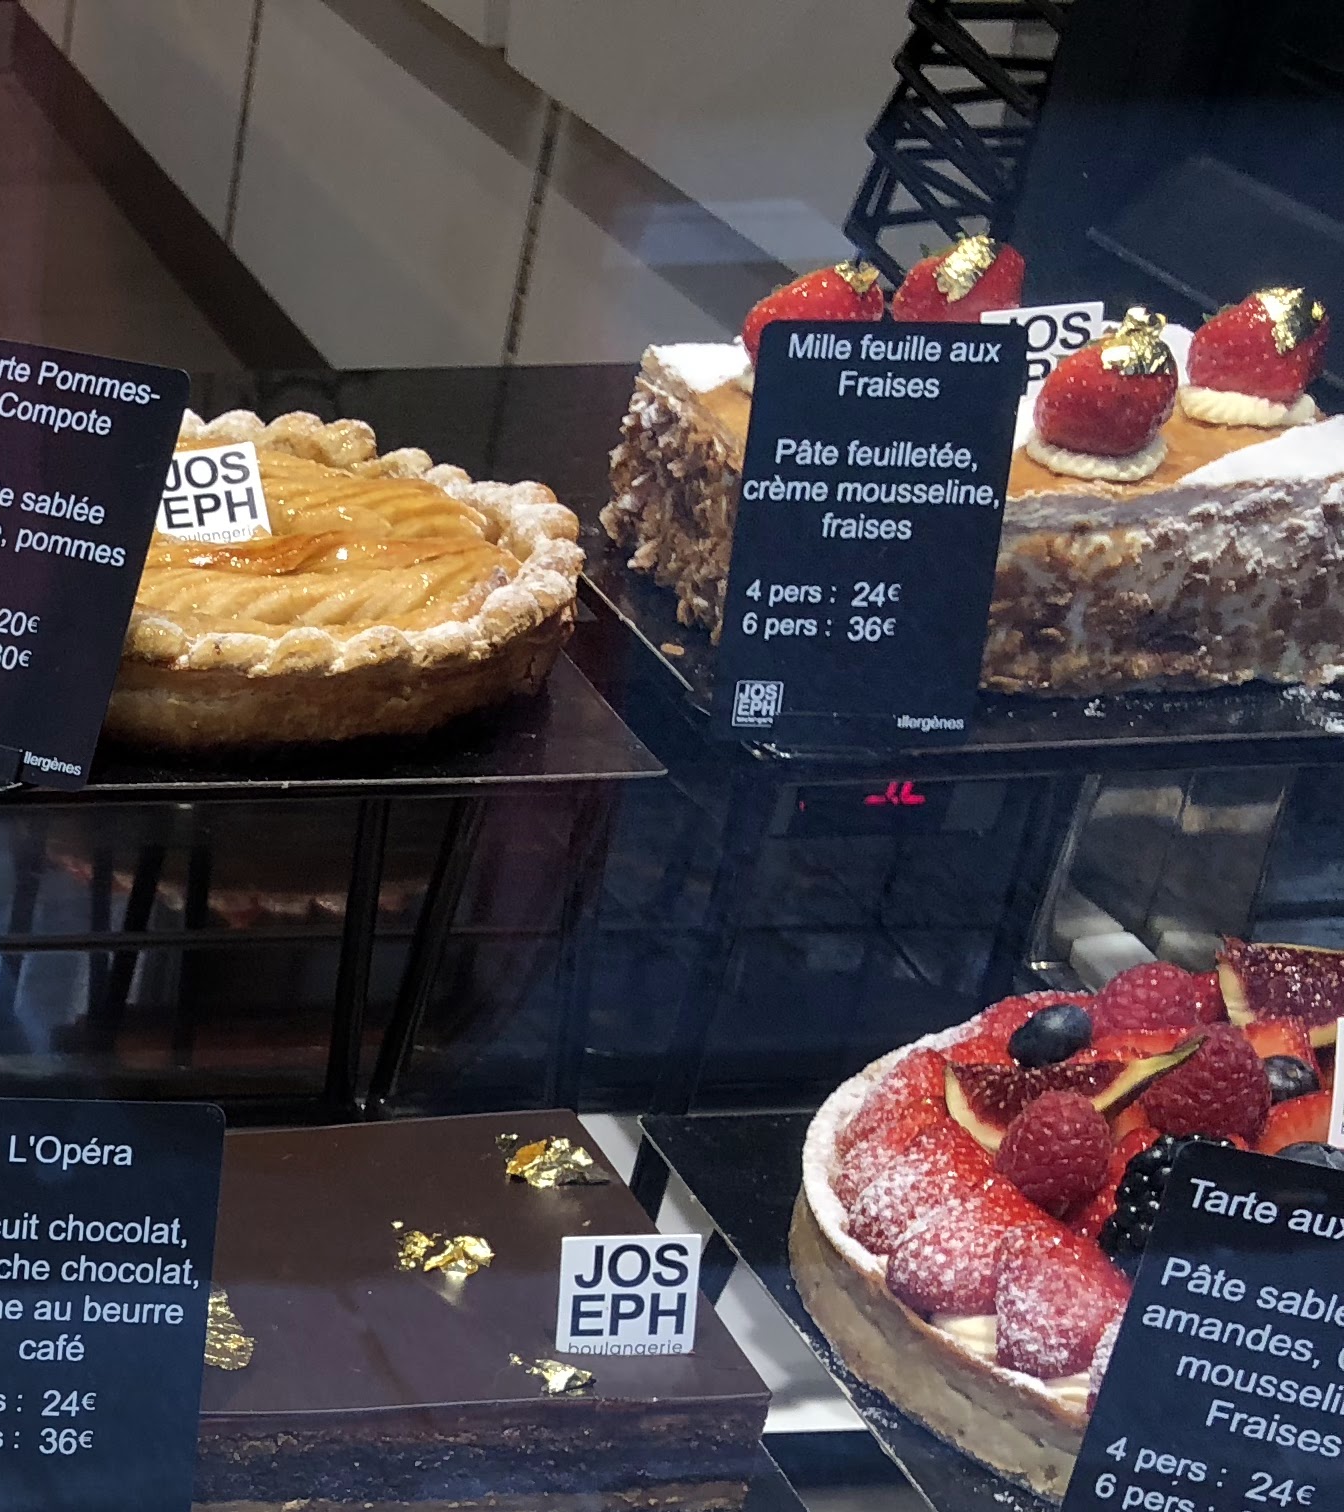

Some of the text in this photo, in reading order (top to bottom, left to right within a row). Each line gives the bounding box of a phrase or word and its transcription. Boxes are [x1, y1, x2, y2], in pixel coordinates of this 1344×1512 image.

[789, 333, 1001, 362] Mille feuille aux
[38, 361, 160, 404] Pommes-
[839, 370, 939, 398] Fraises
[164, 451, 250, 492] JOS
[775, 439, 977, 472] Pâte feuilletée,
[21, 492, 104, 524] sablée
[162, 487, 258, 529] EPH
[743, 475, 999, 509] crème mousseline,
[822, 512, 911, 539] fraises
[15, 529, 125, 566] pommes
[746, 579, 901, 607] 4 pers 24€
[743, 612, 896, 641] 6 pers 36€
[9, 1135, 132, 1170] L'Opéra
[1191, 1178, 1277, 1223] Tarte
[49, 1214, 186, 1248] chocolat,
[61, 1255, 198, 1289] chocolat,
[574, 1243, 689, 1289] JOS
[1161, 1257, 1245, 1301] Pâte
[34, 1301, 71, 1321] au
[84, 1295, 183, 1324] beurre
[569, 1292, 687, 1337] EPH
[19, 1334, 84, 1361] café
[1143, 1305, 1320, 1368] amandes,
[42, 1390, 96, 1416] 24€
[39, 1428, 93, 1454] 36€
[1206, 1393, 1344, 1456] Fraises
[1095, 1474, 1116, 1498] 6
[1106, 1437, 1315, 1507] 4 pers 24€
